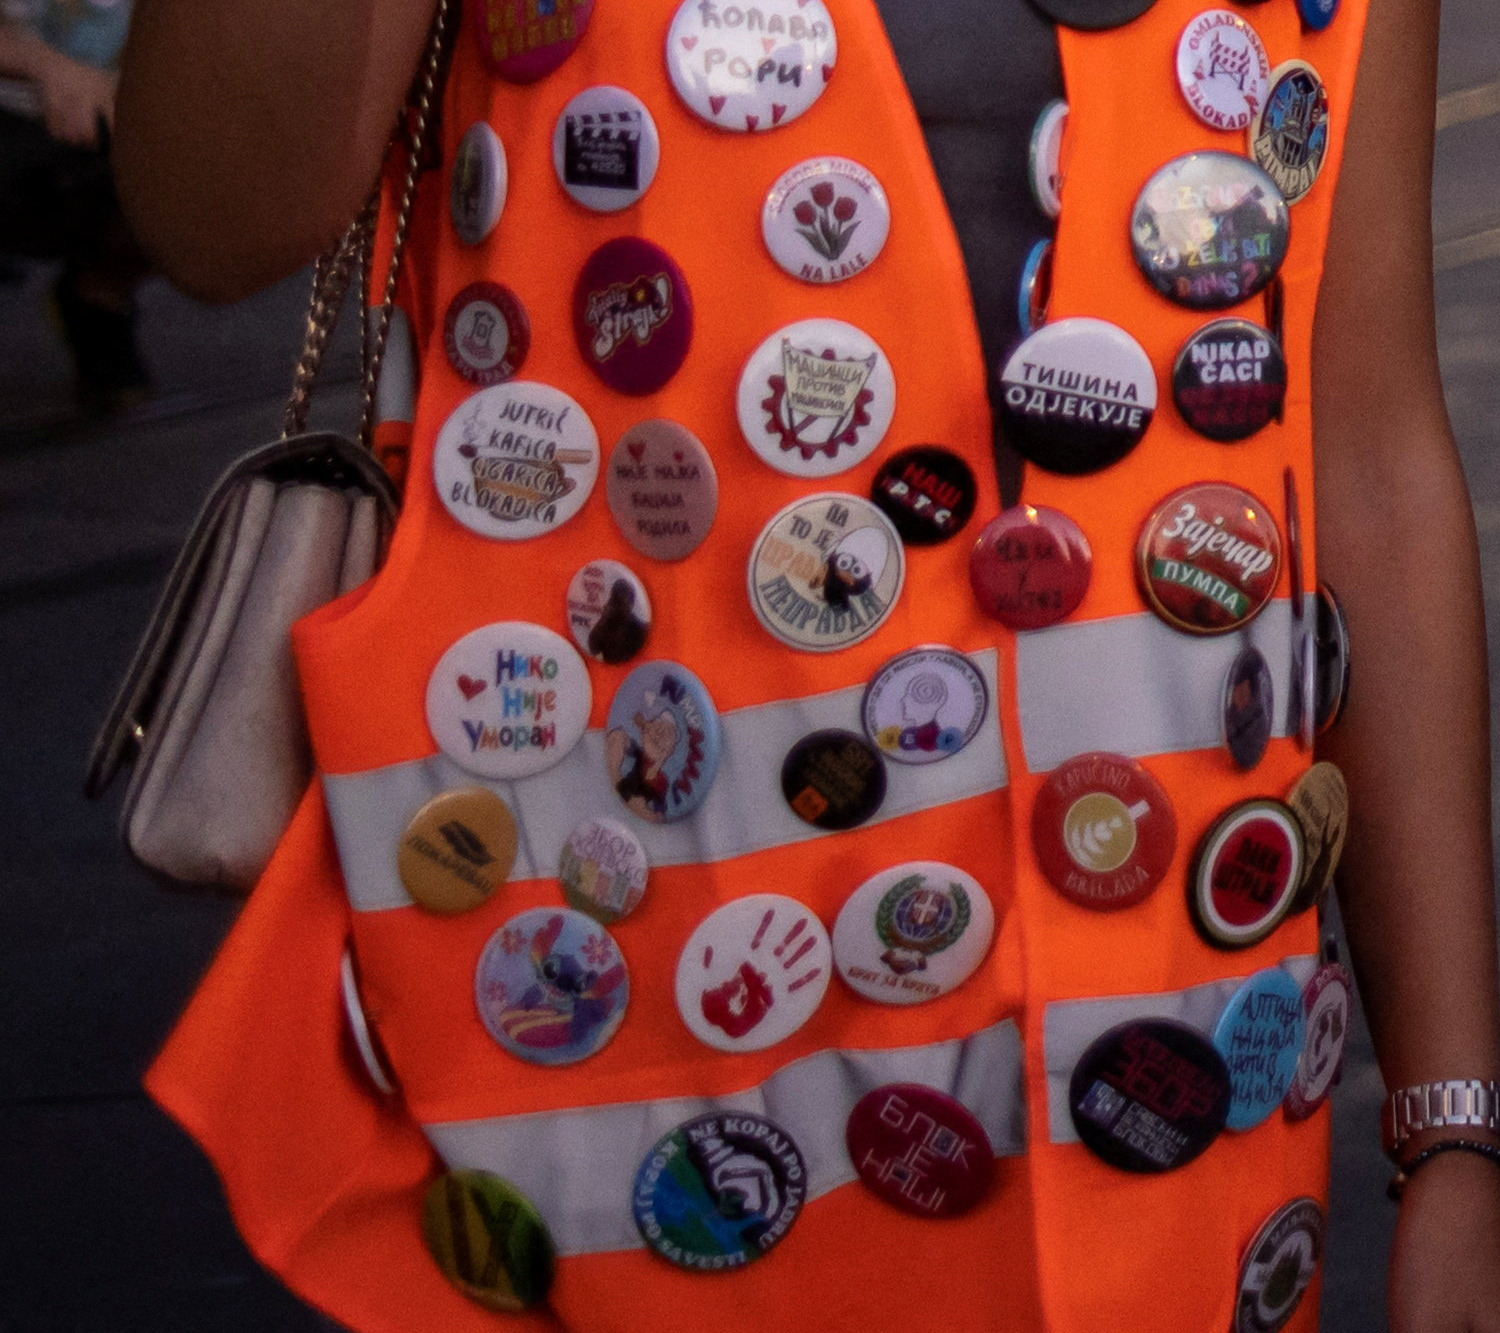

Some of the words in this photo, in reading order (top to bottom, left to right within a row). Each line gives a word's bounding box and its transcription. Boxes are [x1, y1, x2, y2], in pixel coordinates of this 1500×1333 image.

[802, 262, 824, 282] NA
[829, 252, 867, 280] LALE
[1191, 339, 1271, 364] NIKAD
[796, 375, 846, 396] ПРОТИВ
[1022, 361, 1139, 402] ТИШИНА
[1004, 385, 1144, 429] ОДЈЕКУЈЕ
[789, 514, 813, 539] ТО
[1161, 502, 1274, 583] Зајечар
[1163, 560, 1240, 613] ПУМПА
[495, 648, 558, 688] Нико
[501, 686, 557, 721] Није
[461, 719, 556, 753] Уморан
[1065, 864, 1150, 900] BRIGADA
[688, 1120, 718, 1143] NE
[879, 1094, 976, 1172] БЛОК
[901, 1141, 936, 1178] ЈЕ
